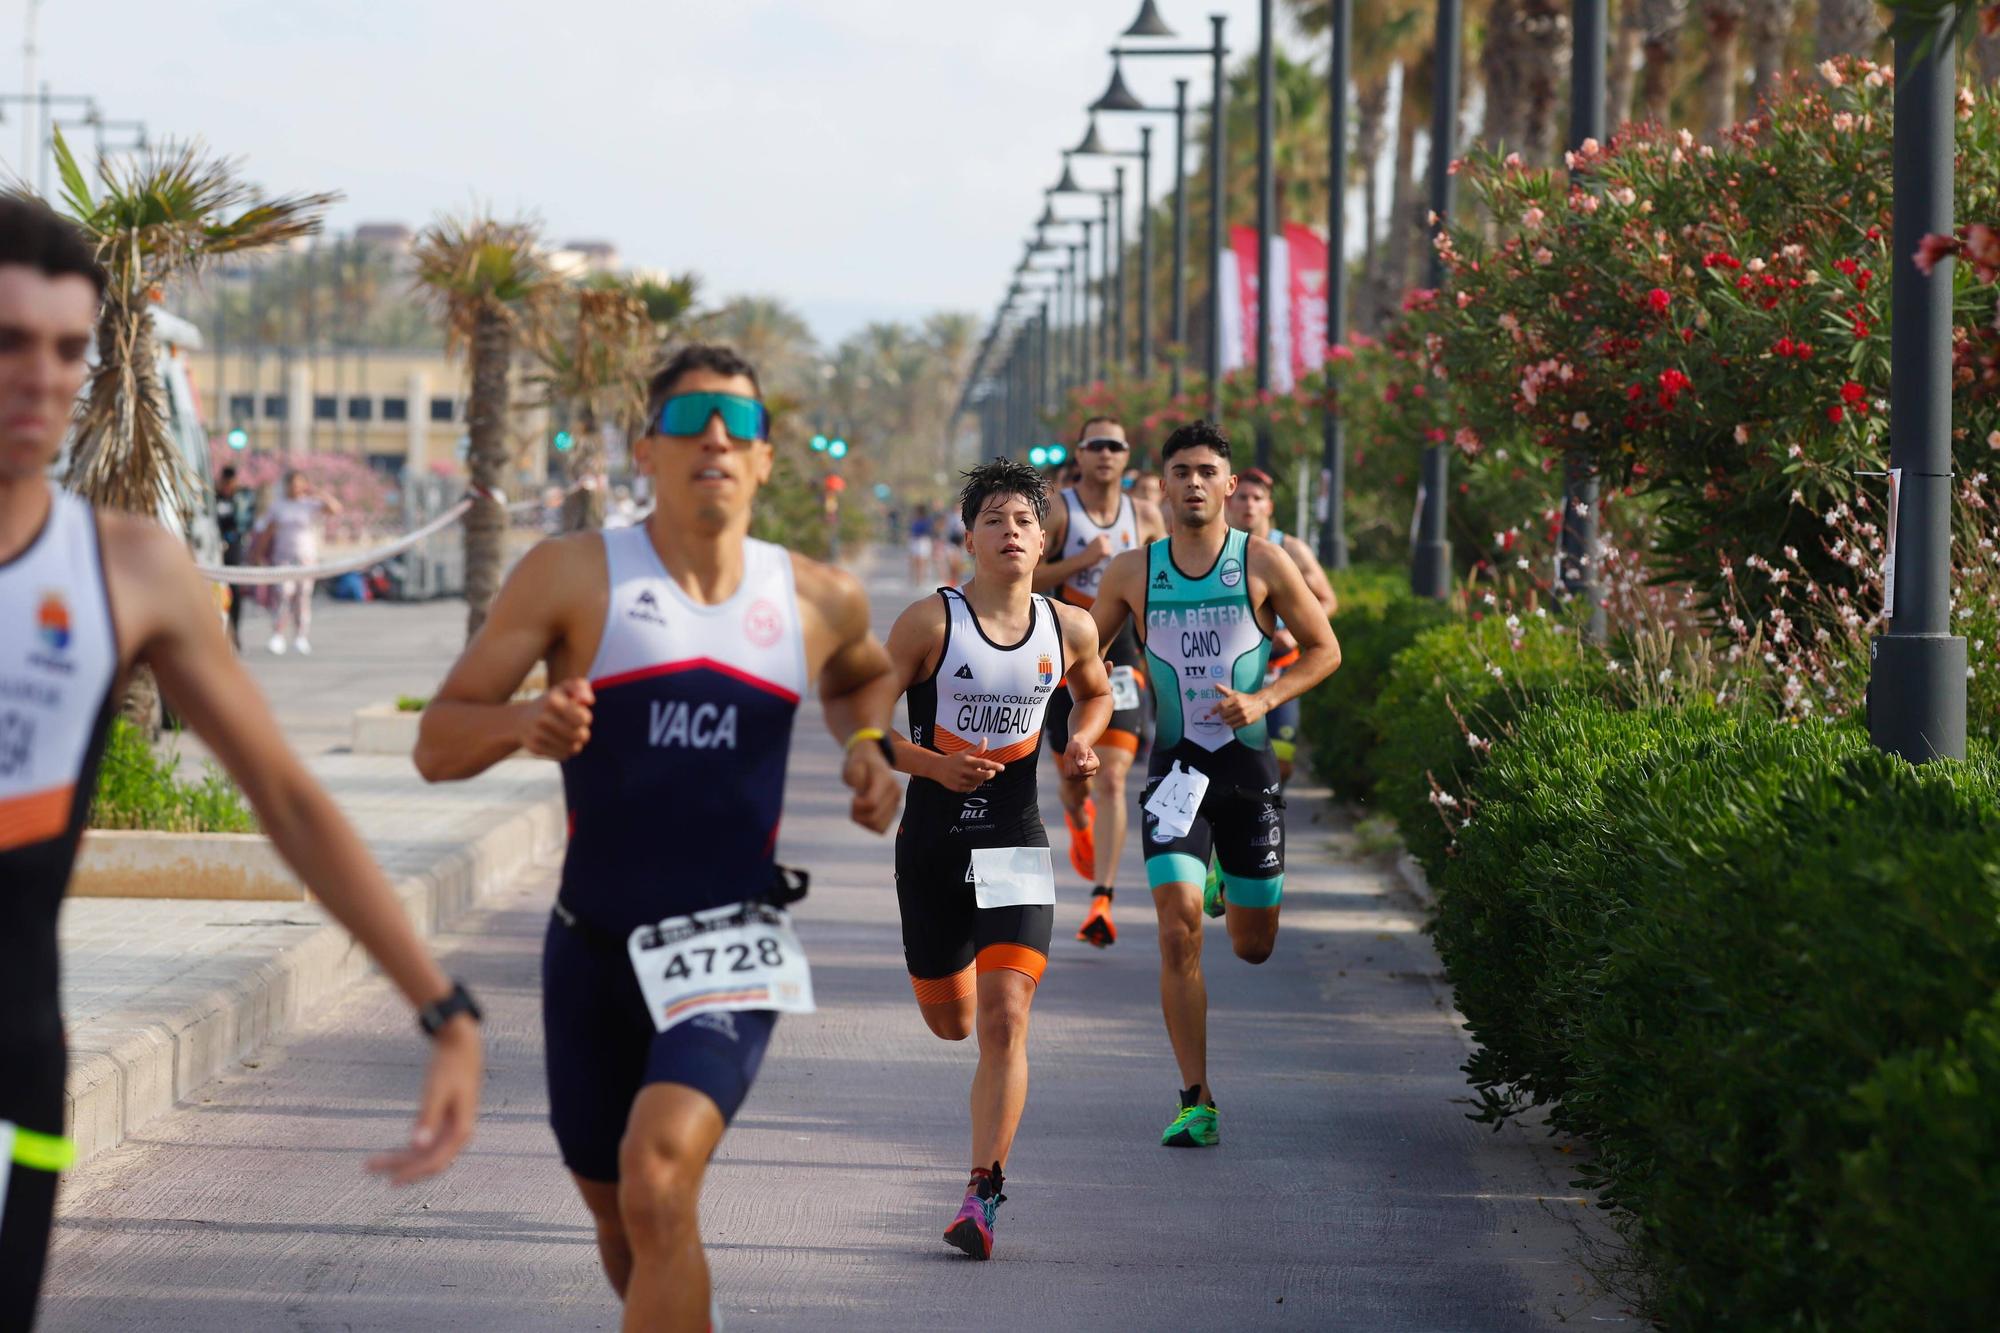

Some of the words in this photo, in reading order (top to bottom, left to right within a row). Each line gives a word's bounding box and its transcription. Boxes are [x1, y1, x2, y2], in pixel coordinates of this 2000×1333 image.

[1149, 608, 1179, 629] CEA
[1185, 603, 1251, 627] BÉTERA
[1181, 630, 1221, 658] CANO
[1185, 666, 1206, 676] ITV
[953, 693, 999, 703] CAXTON
[649, 700, 738, 749] VACA
[957, 705, 1034, 734] GUMBAU
[960, 808, 989, 819] RLC
[663, 937, 784, 981] 4728
